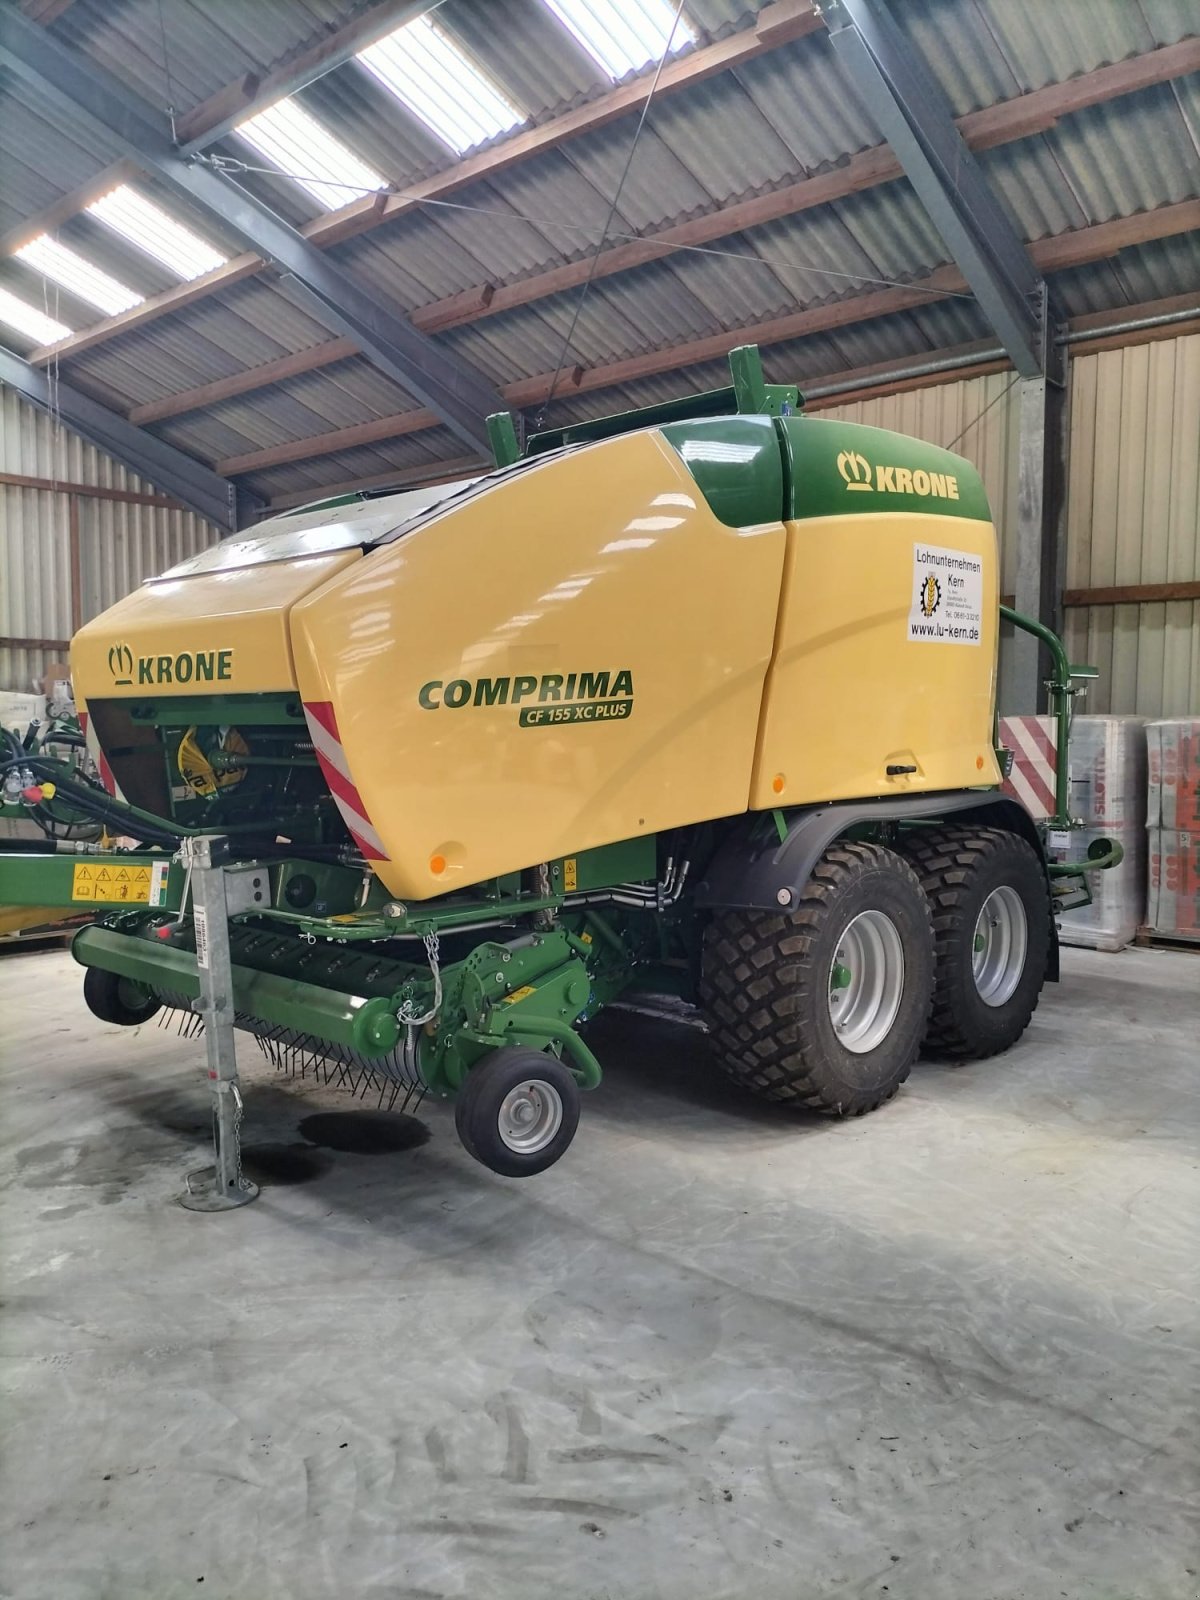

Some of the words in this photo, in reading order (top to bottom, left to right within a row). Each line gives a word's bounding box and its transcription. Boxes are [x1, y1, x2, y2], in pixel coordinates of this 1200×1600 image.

[876, 466, 960, 500] KRONE
[916, 549, 980, 573] Lohnunternehmen
[947, 574, 964, 588] Kern
[911, 623, 979, 640] www.lu-kern.de
[138, 650, 233, 684] KRONE
[418, 670, 634, 710] COMPRIMA
[526, 710, 544, 724] CF
[548, 708, 571, 722] 155
[574, 706, 593, 719] XC
[595, 703, 627, 718] PLUS
